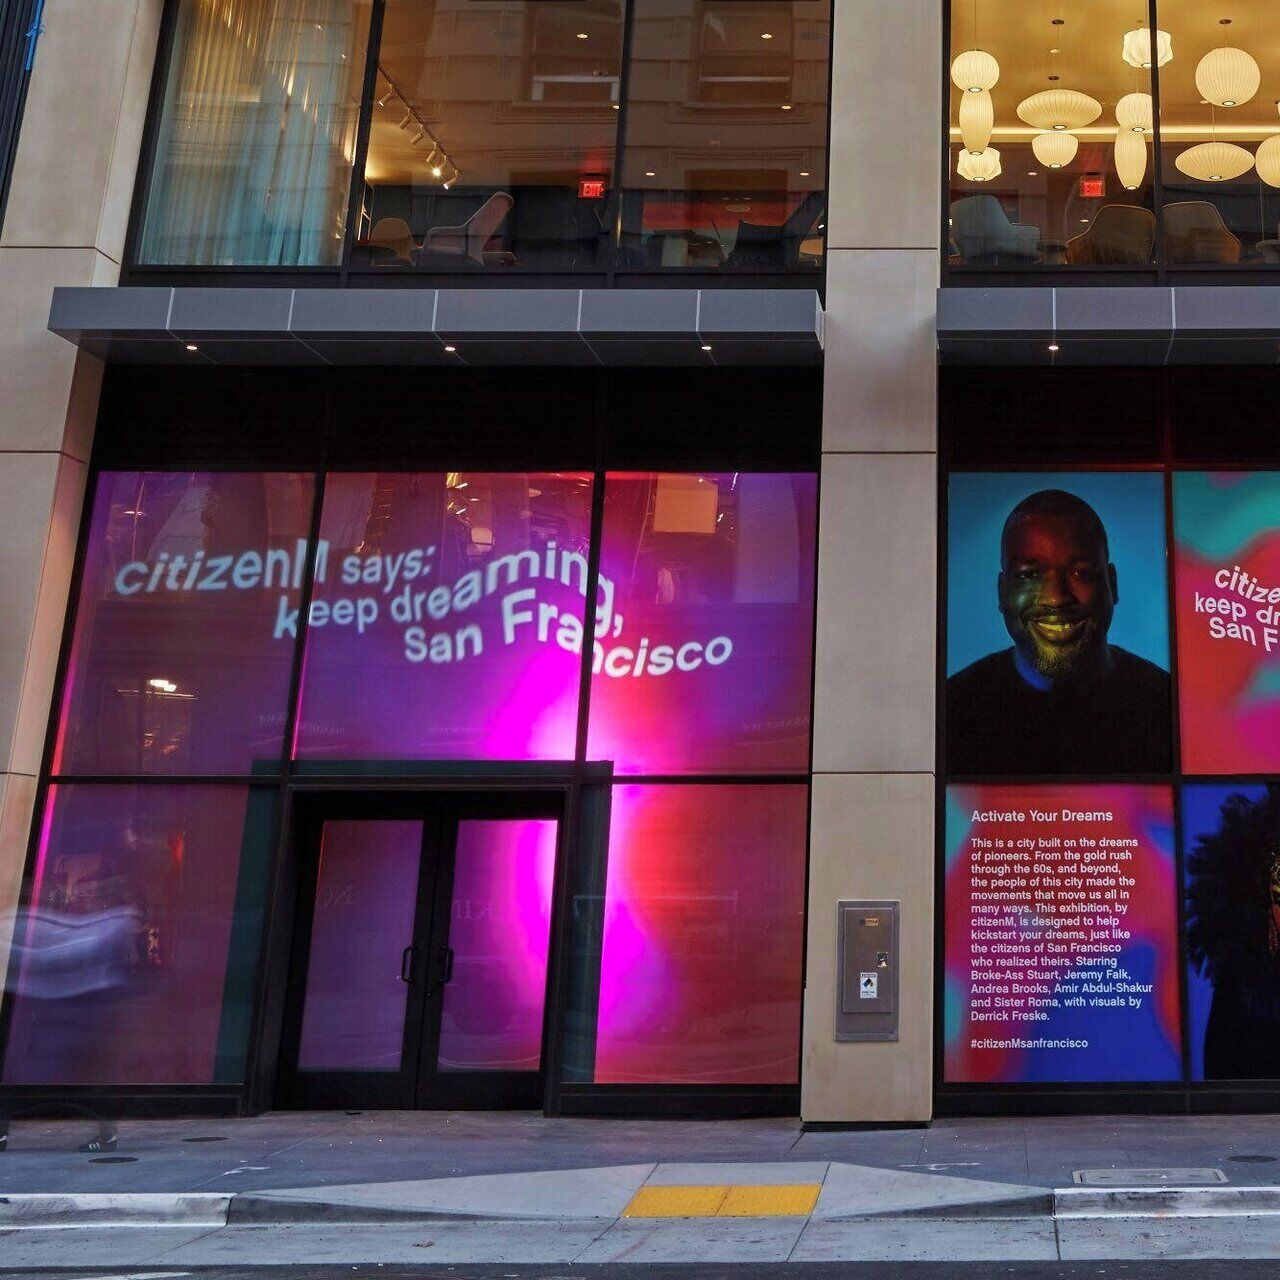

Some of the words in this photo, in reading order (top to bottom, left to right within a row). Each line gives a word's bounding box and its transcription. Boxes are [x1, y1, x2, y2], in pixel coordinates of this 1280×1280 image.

[114, 538, 329, 595] citizenM
[341, 544, 436, 594] says:
[273, 595, 378, 639] keep
[390, 541, 623, 638] dreaming,
[1195, 592, 1246, 621] keep
[404, 624, 483, 663] San
[503, 588, 733, 678] Francisco
[1210, 617, 1257, 646] San
[971, 810, 1025, 822] Activate
[1030, 810, 1057, 822] Your
[1062, 810, 1113, 822] Dreams
[971, 838, 992, 848] This
[996, 838, 1004, 847] is
[1017, 838, 1035, 849] city
[1039, 838, 1060, 847] built
[1080, 838, 1096, 847] the
[1099, 838, 1138, 847] dreams
[971, 852, 982, 860] of
[985, 852, 1031, 863] pioneers.
[1035, 851, 1061, 860] From
[1064, 851, 1080, 860] the
[1084, 851, 1106, 862] gold
[1110, 851, 1132, 860] rush
[971, 865, 1010, 876] through
[1014, 865, 1030, 873] the
[1034, 864, 1054, 875] 60s,
[1058, 864, 1077, 873] and
[1081, 864, 1121, 875] beyond,
[971, 878, 987, 886] the
[991, 878, 1026, 889] people
[1030, 877, 1040, 886] of
[1043, 877, 1061, 886] this
[1064, 877, 1083, 888] city
[1086, 877, 1116, 886] made
[1119, 877, 1135, 886] the
[971, 891, 1031, 900] movements
[1035, 890, 1054, 899] that
[1105, 890, 1117, 899] all
[1120, 890, 1129, 899] in
[971, 906, 999, 915] many
[1003, 906, 1031, 915] ways.
[1035, 903, 1056, 913] This
[1059, 903, 1112, 914] exhibition,
[1115, 903, 1127, 914] by
[971, 917, 1016, 928] citizenM,
[1020, 917, 1028, 925] is
[1032, 917, 1079, 928] designed
[1097, 916, 1119, 927] help
[971, 930, 1016, 939] kickstart
[1020, 932, 1041, 942] your
[1045, 930, 1087, 940] dreams,
[1090, 930, 1109, 941] just
[1113, 929, 1130, 939] like
[971, 944, 987, 953] the
[991, 944, 1030, 953] citizens
[1034, 943, 1044, 952] of
[1047, 943, 1067, 952] San
[1071, 943, 1121, 952] Francisco
[971, 957, 992, 966] who
[996, 957, 1037, 966] realized
[1041, 957, 1072, 966] theirs.
[1076, 956, 1117, 968] Starring
[971, 971, 1023, 980] Broke-Ass
[1027, 970, 1061, 981] Stuart,
[1065, 970, 1102, 982] Jeremy
[1107, 970, 1131, 980] Falk,
[971, 984, 1008, 993] Andrea
[1012, 984, 1050, 995] Brooks,
[1055, 984, 1078, 993] Amir
[1082, 983, 1152, 993] Abdul-Shakur
[971, 998, 990, 1007] and
[994, 997, 1024, 1007] Sister
[1028, 997, 1061, 1007] Roma,
[1065, 997, 1086, 1006] with
[1089, 997, 1125, 1006] visuals
[1129, 997, 1141, 1008] by
[971, 1011, 1008, 1021] Derrick
[1012, 1011, 1050, 1020] Freske.
[971, 1039, 1088, 1048] #citizenMsanfrancisco
